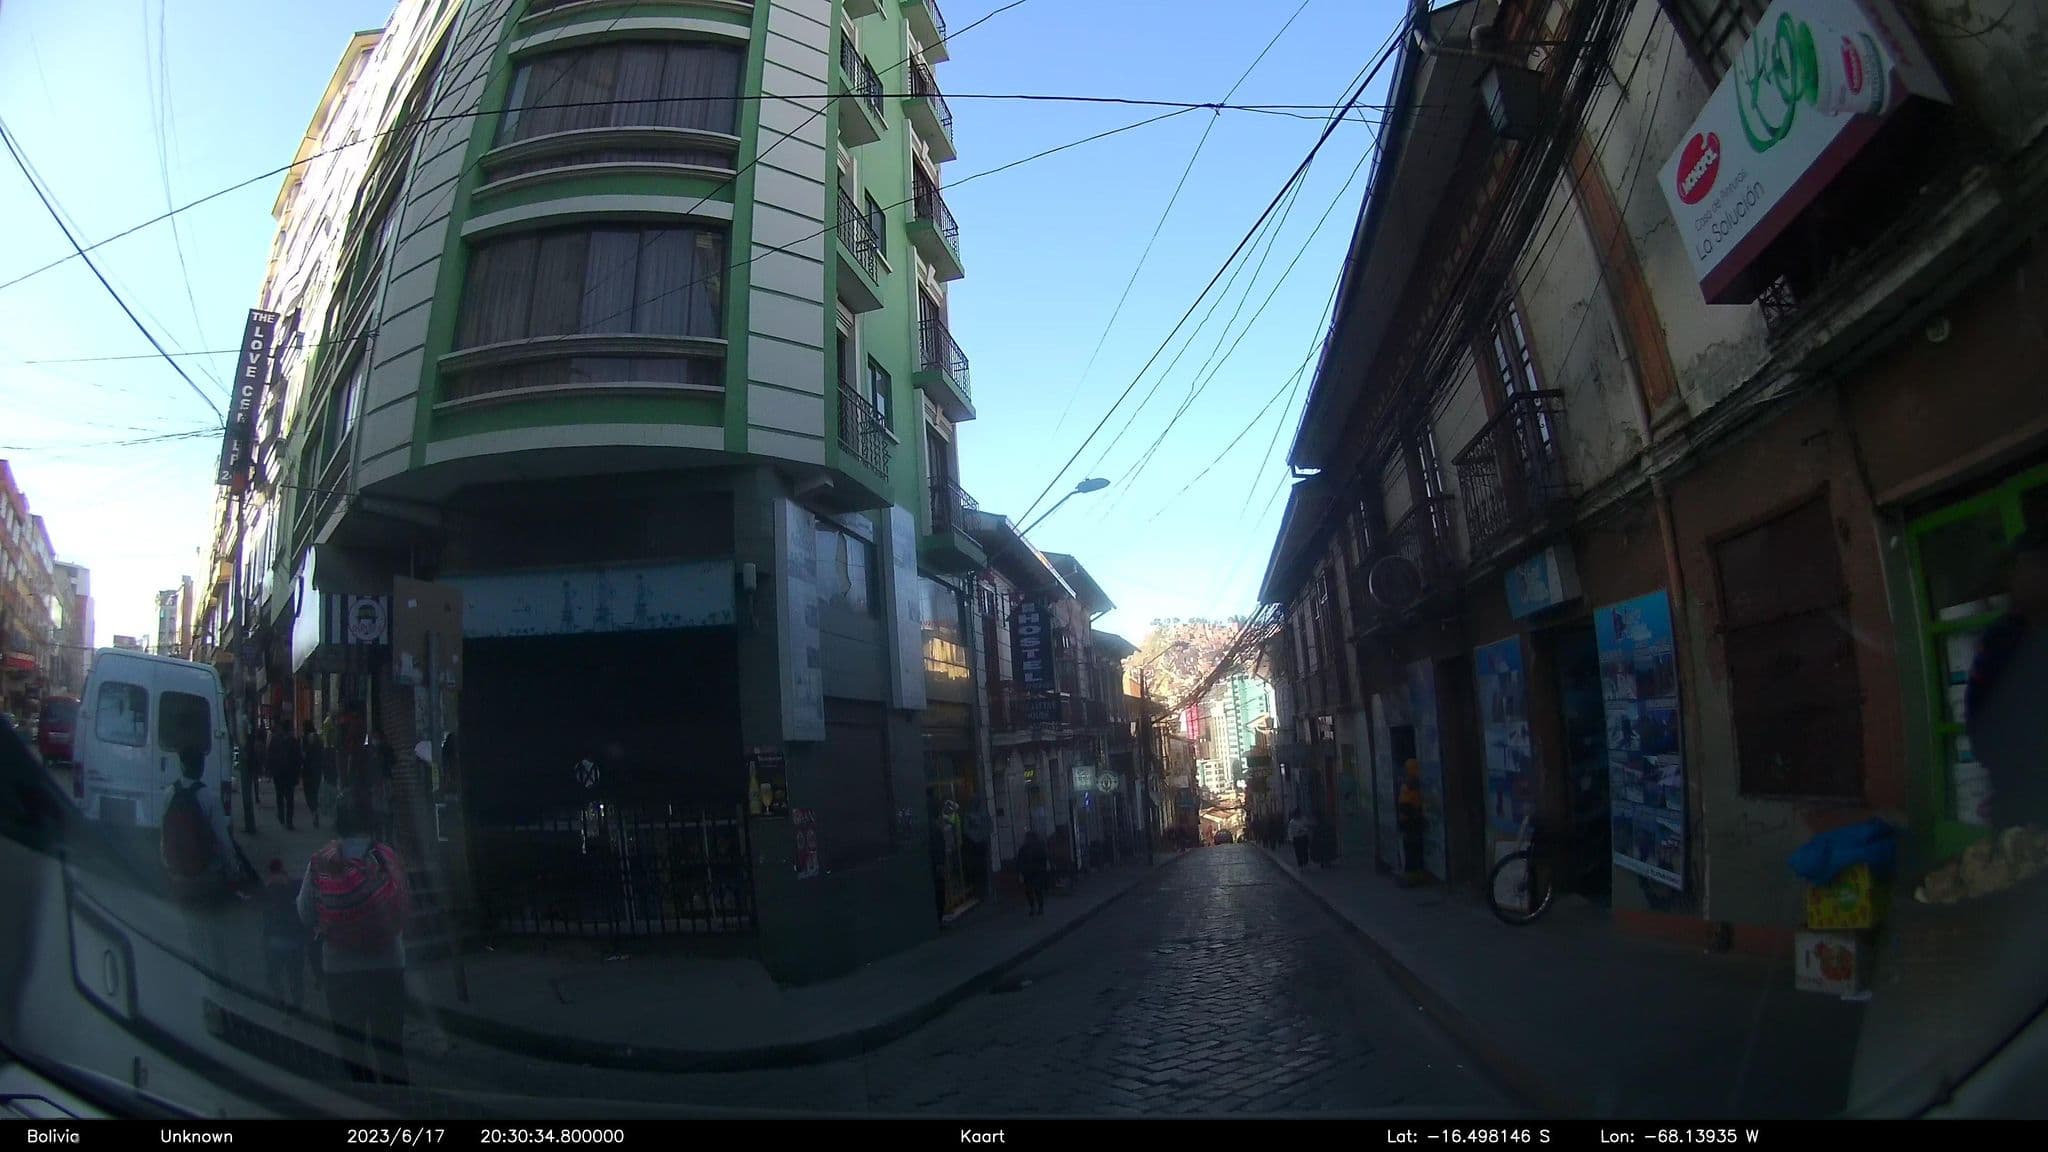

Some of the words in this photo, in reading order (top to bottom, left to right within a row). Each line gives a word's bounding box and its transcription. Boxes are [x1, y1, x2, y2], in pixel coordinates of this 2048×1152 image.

[1682, 148, 1718, 196] MONOPOL
[1696, 239, 1713, 260] La
[1711, 181, 1766, 242] Solución
[251, 311, 276, 324] THE
[245, 326, 264, 379] LOVE
[1018, 612, 1042, 683] HOSTEL
